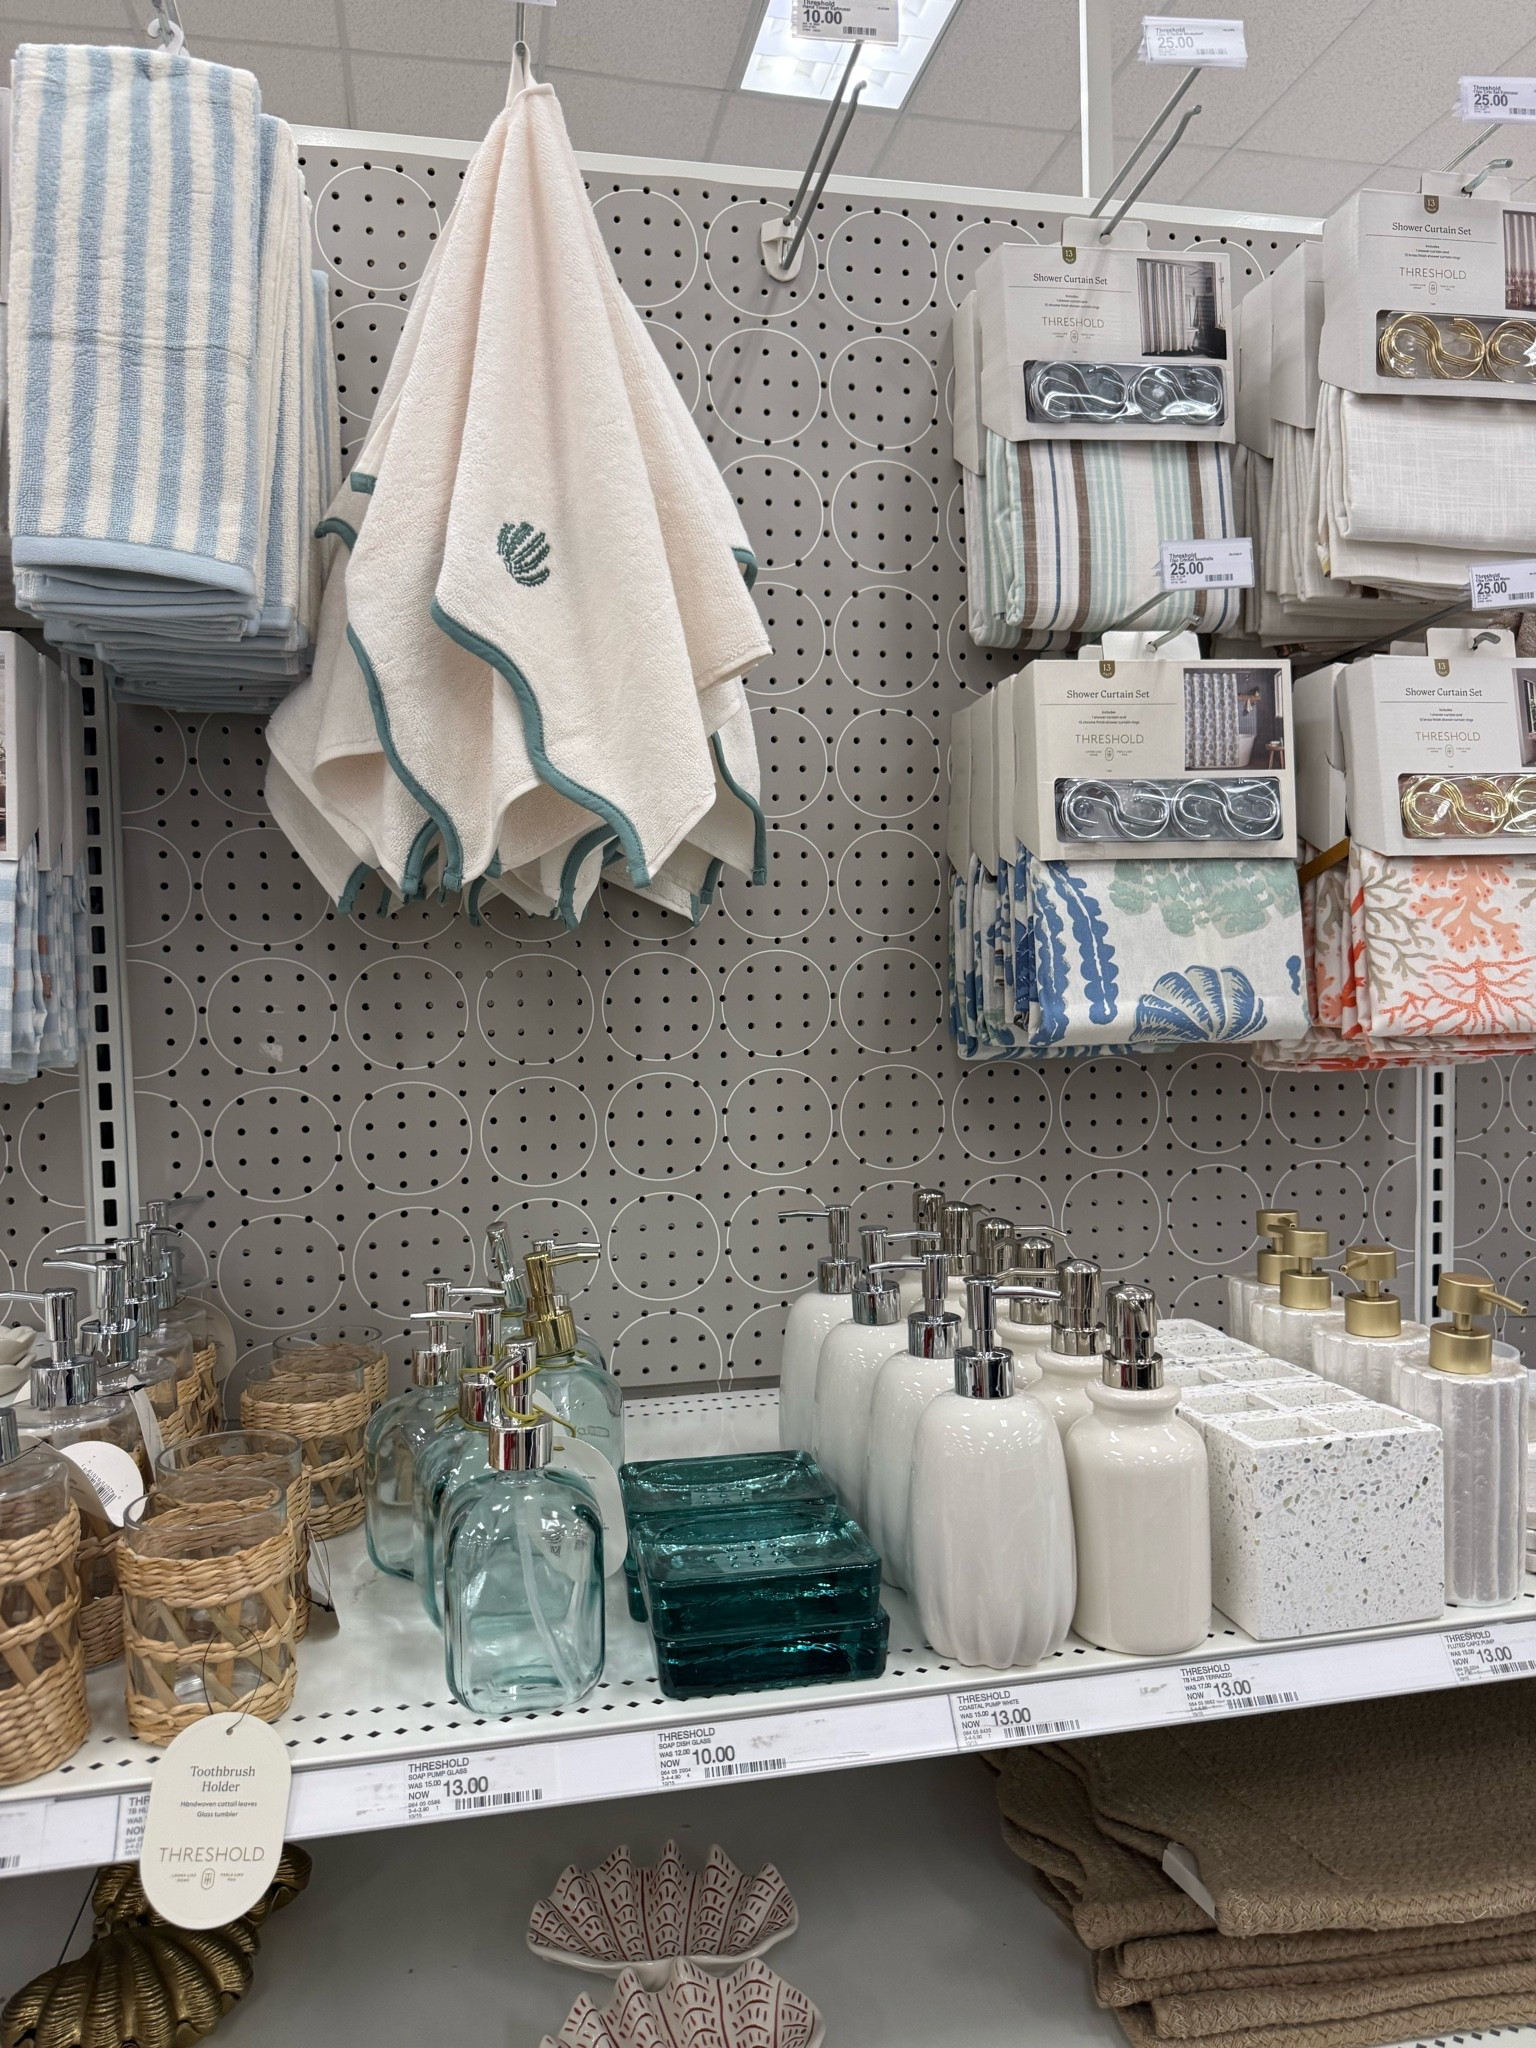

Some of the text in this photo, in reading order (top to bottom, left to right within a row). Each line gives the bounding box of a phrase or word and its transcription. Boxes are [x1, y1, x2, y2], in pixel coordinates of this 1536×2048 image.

[803, 9, 842, 25] 10.00
[1158, 36, 1194, 49] 25.00
[1474, 94, 1508, 106] 25.00
[1427, 199, 1435, 207] 13
[1392, 222, 1471, 235] Shower Curtain Set
[1033, 273, 1108, 285] Shower Curtain Set
[1400, 266, 1467, 280] THRESHOLD
[1042, 316, 1105, 328] THRESHOLD
[1170, 562, 1204, 575] 25.00
[1477, 581, 1507, 595] 25.00
[1103, 663, 1111, 671] 13
[1438, 662, 1446, 670] 13
[1067, 689, 1150, 698] Shower Curtain Set
[1405, 688, 1482, 697] Shower Curtain Set
[1075, 734, 1144, 744] THRESHOLD
[1416, 731, 1480, 741] THRESHOLD
[1444, 1631, 1490, 1643] THRESHOLD
[1452, 1646, 1512, 1666] NOW 13.00
[1180, 1664, 1230, 1676] THRESHOLD
[1205, 1672, 1232, 1680] TERRAZZO
[1187, 1680, 1251, 1700] NOW 13.00
[957, 1691, 1010, 1704] THRESHOLD
[962, 1707, 1031, 1729] NOW 13.00
[658, 1727, 715, 1742] THRESHOLD
[661, 1745, 735, 1768] NOW 10.00
[190, 1765, 255, 1777] Toothbrush
[408, 1757, 469, 1773] THRESHOLD
[408, 1773, 426, 1781] SOAP
[447, 1768, 467, 1776] GLASS
[201, 1781, 240, 1792] Holder
[409, 1776, 489, 1800] NOW 13.00
[159, 1847, 264, 1862] THRESHOLD
